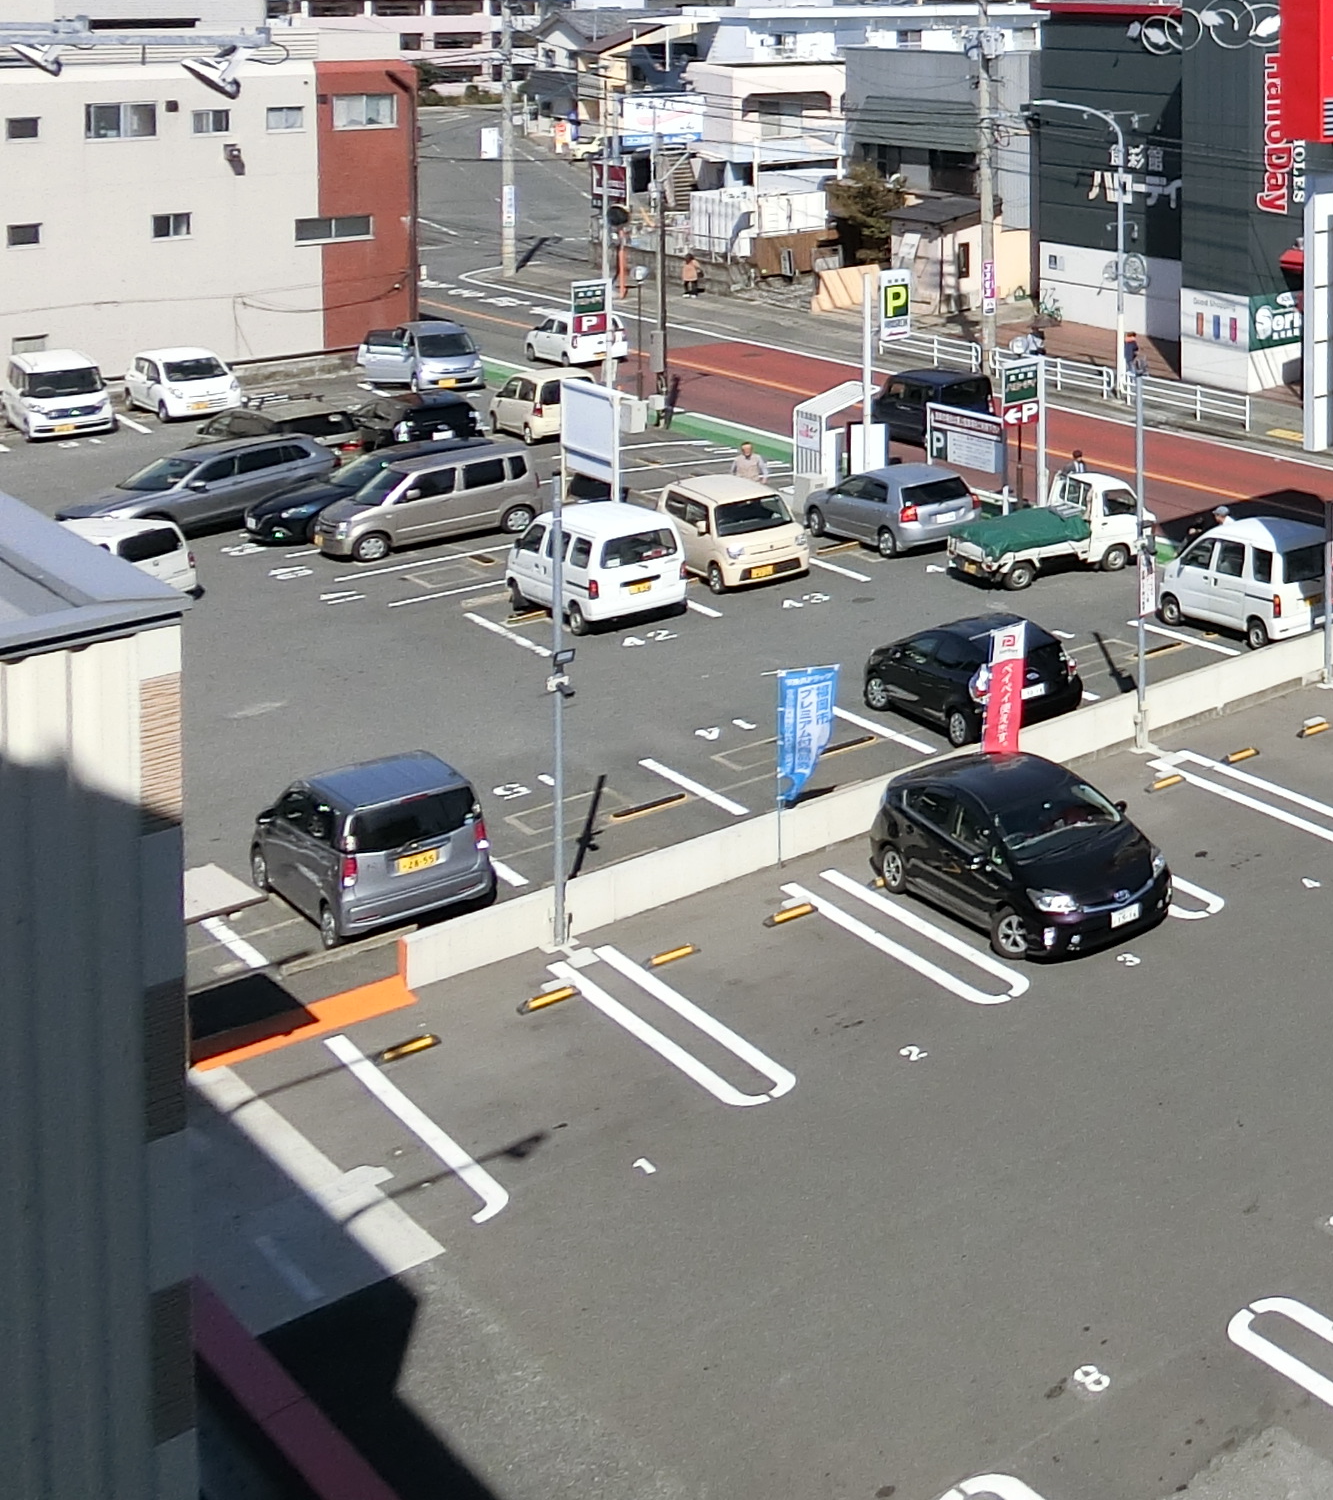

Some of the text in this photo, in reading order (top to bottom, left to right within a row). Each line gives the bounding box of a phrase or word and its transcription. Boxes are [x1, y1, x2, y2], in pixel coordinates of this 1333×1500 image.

[887, 287, 907, 318] P
[581, 316, 598, 332] P
[1022, 402, 1039, 423] P
[932, 431, 945, 456] P
[1116, 953, 1141, 967] 3
[899, 1045, 928, 1062] 2
[632, 1158, 656, 1174] 1
[1074, 1365, 1110, 1392] 8
